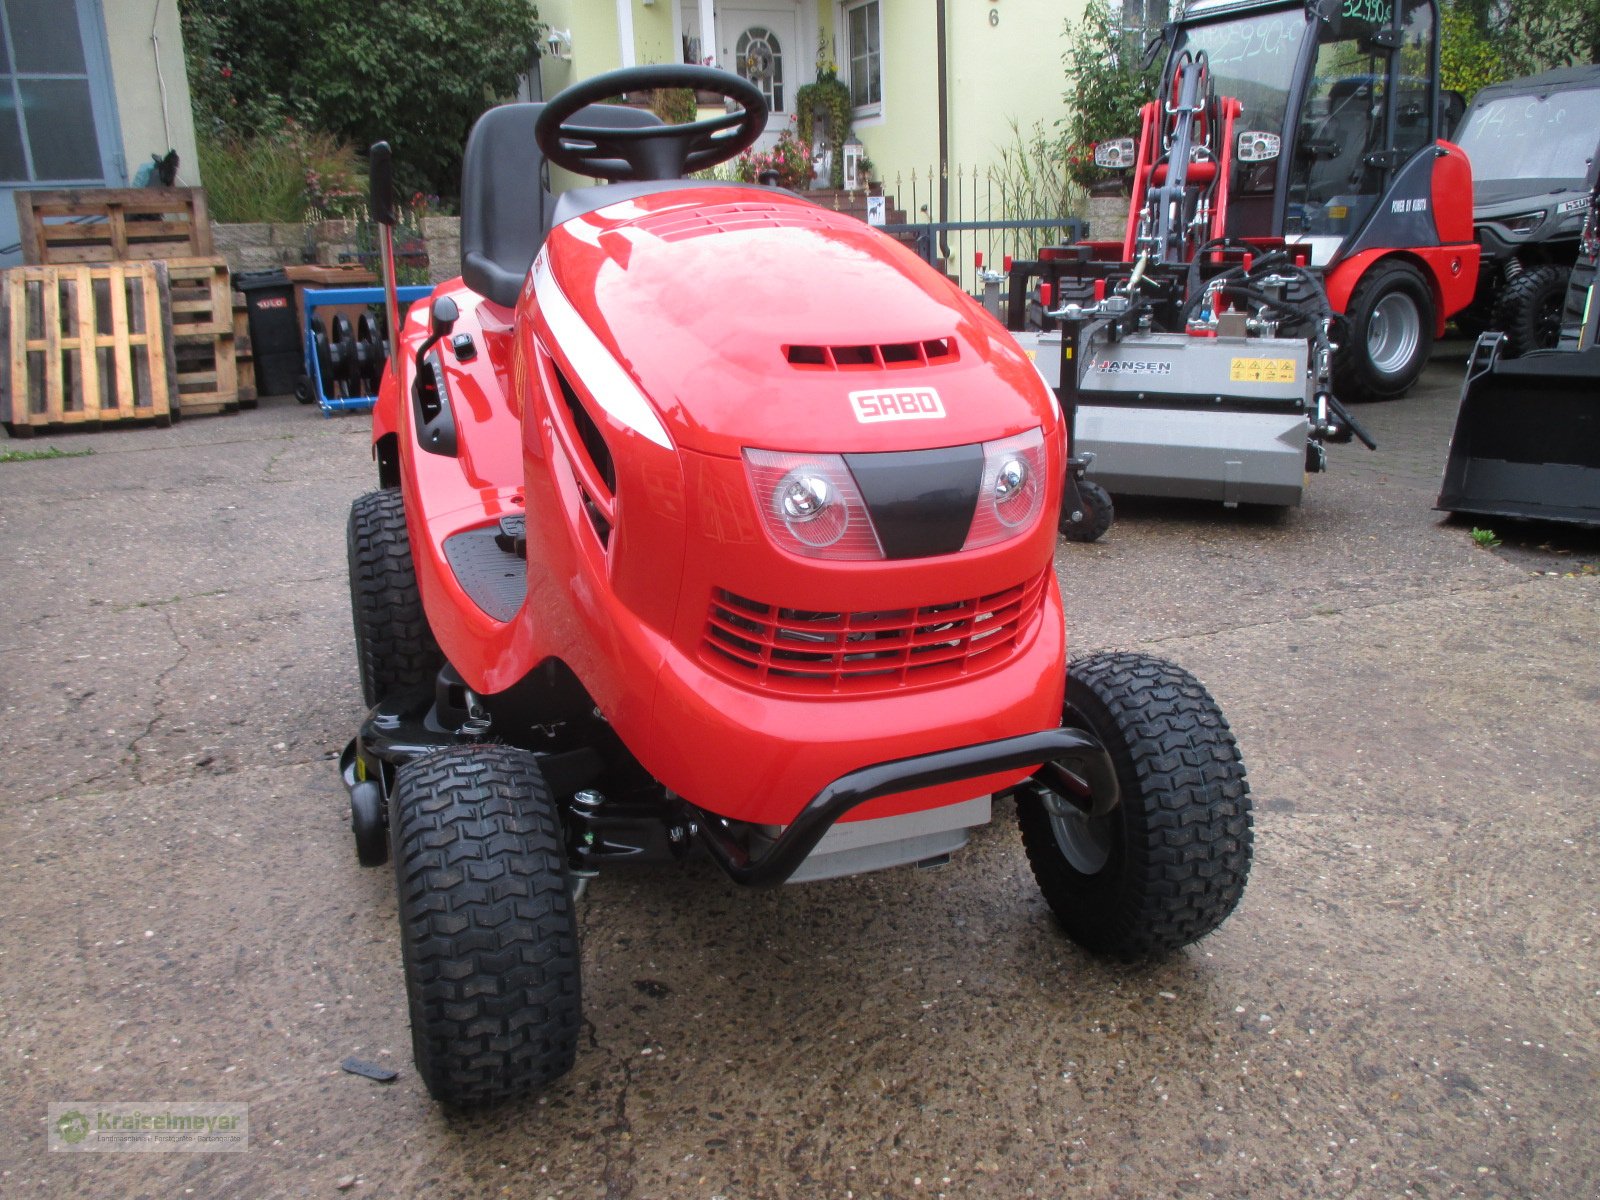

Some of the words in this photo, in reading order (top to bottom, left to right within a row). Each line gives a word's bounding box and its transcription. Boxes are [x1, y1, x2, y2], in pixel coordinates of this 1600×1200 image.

[989, 8, 1000, 27] 6
[1098, 360, 1171, 370] JANSEN
[856, 392, 939, 417] SABO
